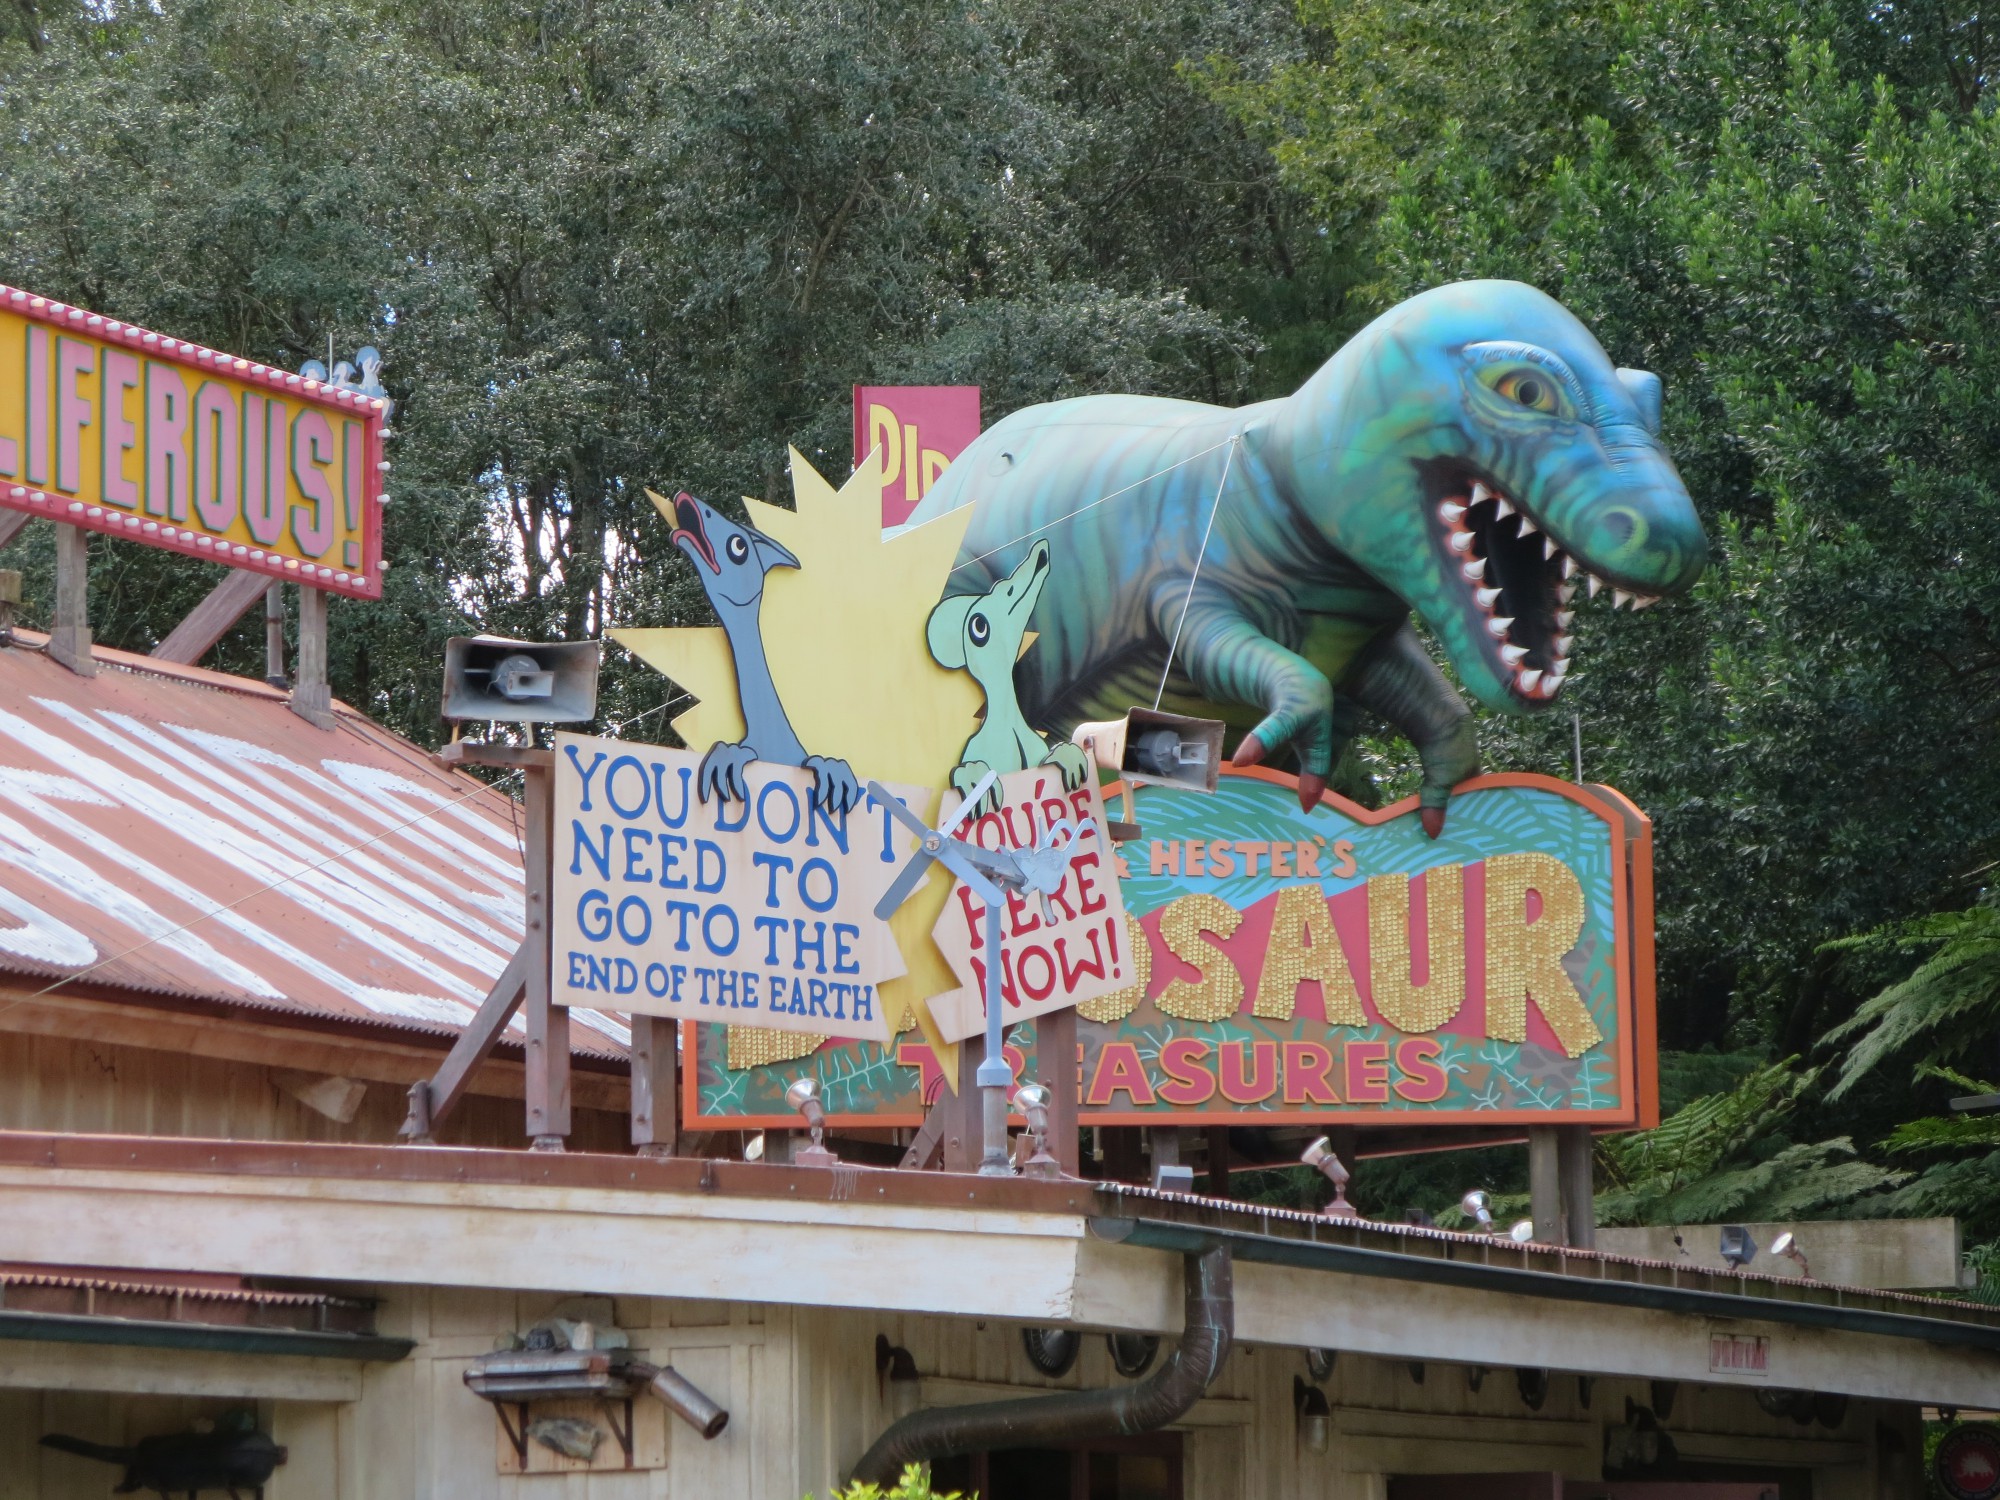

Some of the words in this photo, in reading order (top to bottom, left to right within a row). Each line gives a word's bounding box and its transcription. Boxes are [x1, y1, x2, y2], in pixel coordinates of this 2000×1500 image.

[563, 744, 692, 829] YOU
[713, 779, 907, 863] DON'T
[569, 819, 727, 894] NEED
[753, 851, 838, 913] TO
[1150, 834, 1358, 879] HESTER'S
[577, 889, 652, 946] GO
[666, 900, 739, 957] TO
[754, 916, 860, 975] THE
[969, 917, 1121, 1018] NOW!
[567, 951, 638, 994] END
[645, 962, 687, 1002] OF
[694, 967, 759, 1008] THE
[769, 976, 873, 1021] EARTH
